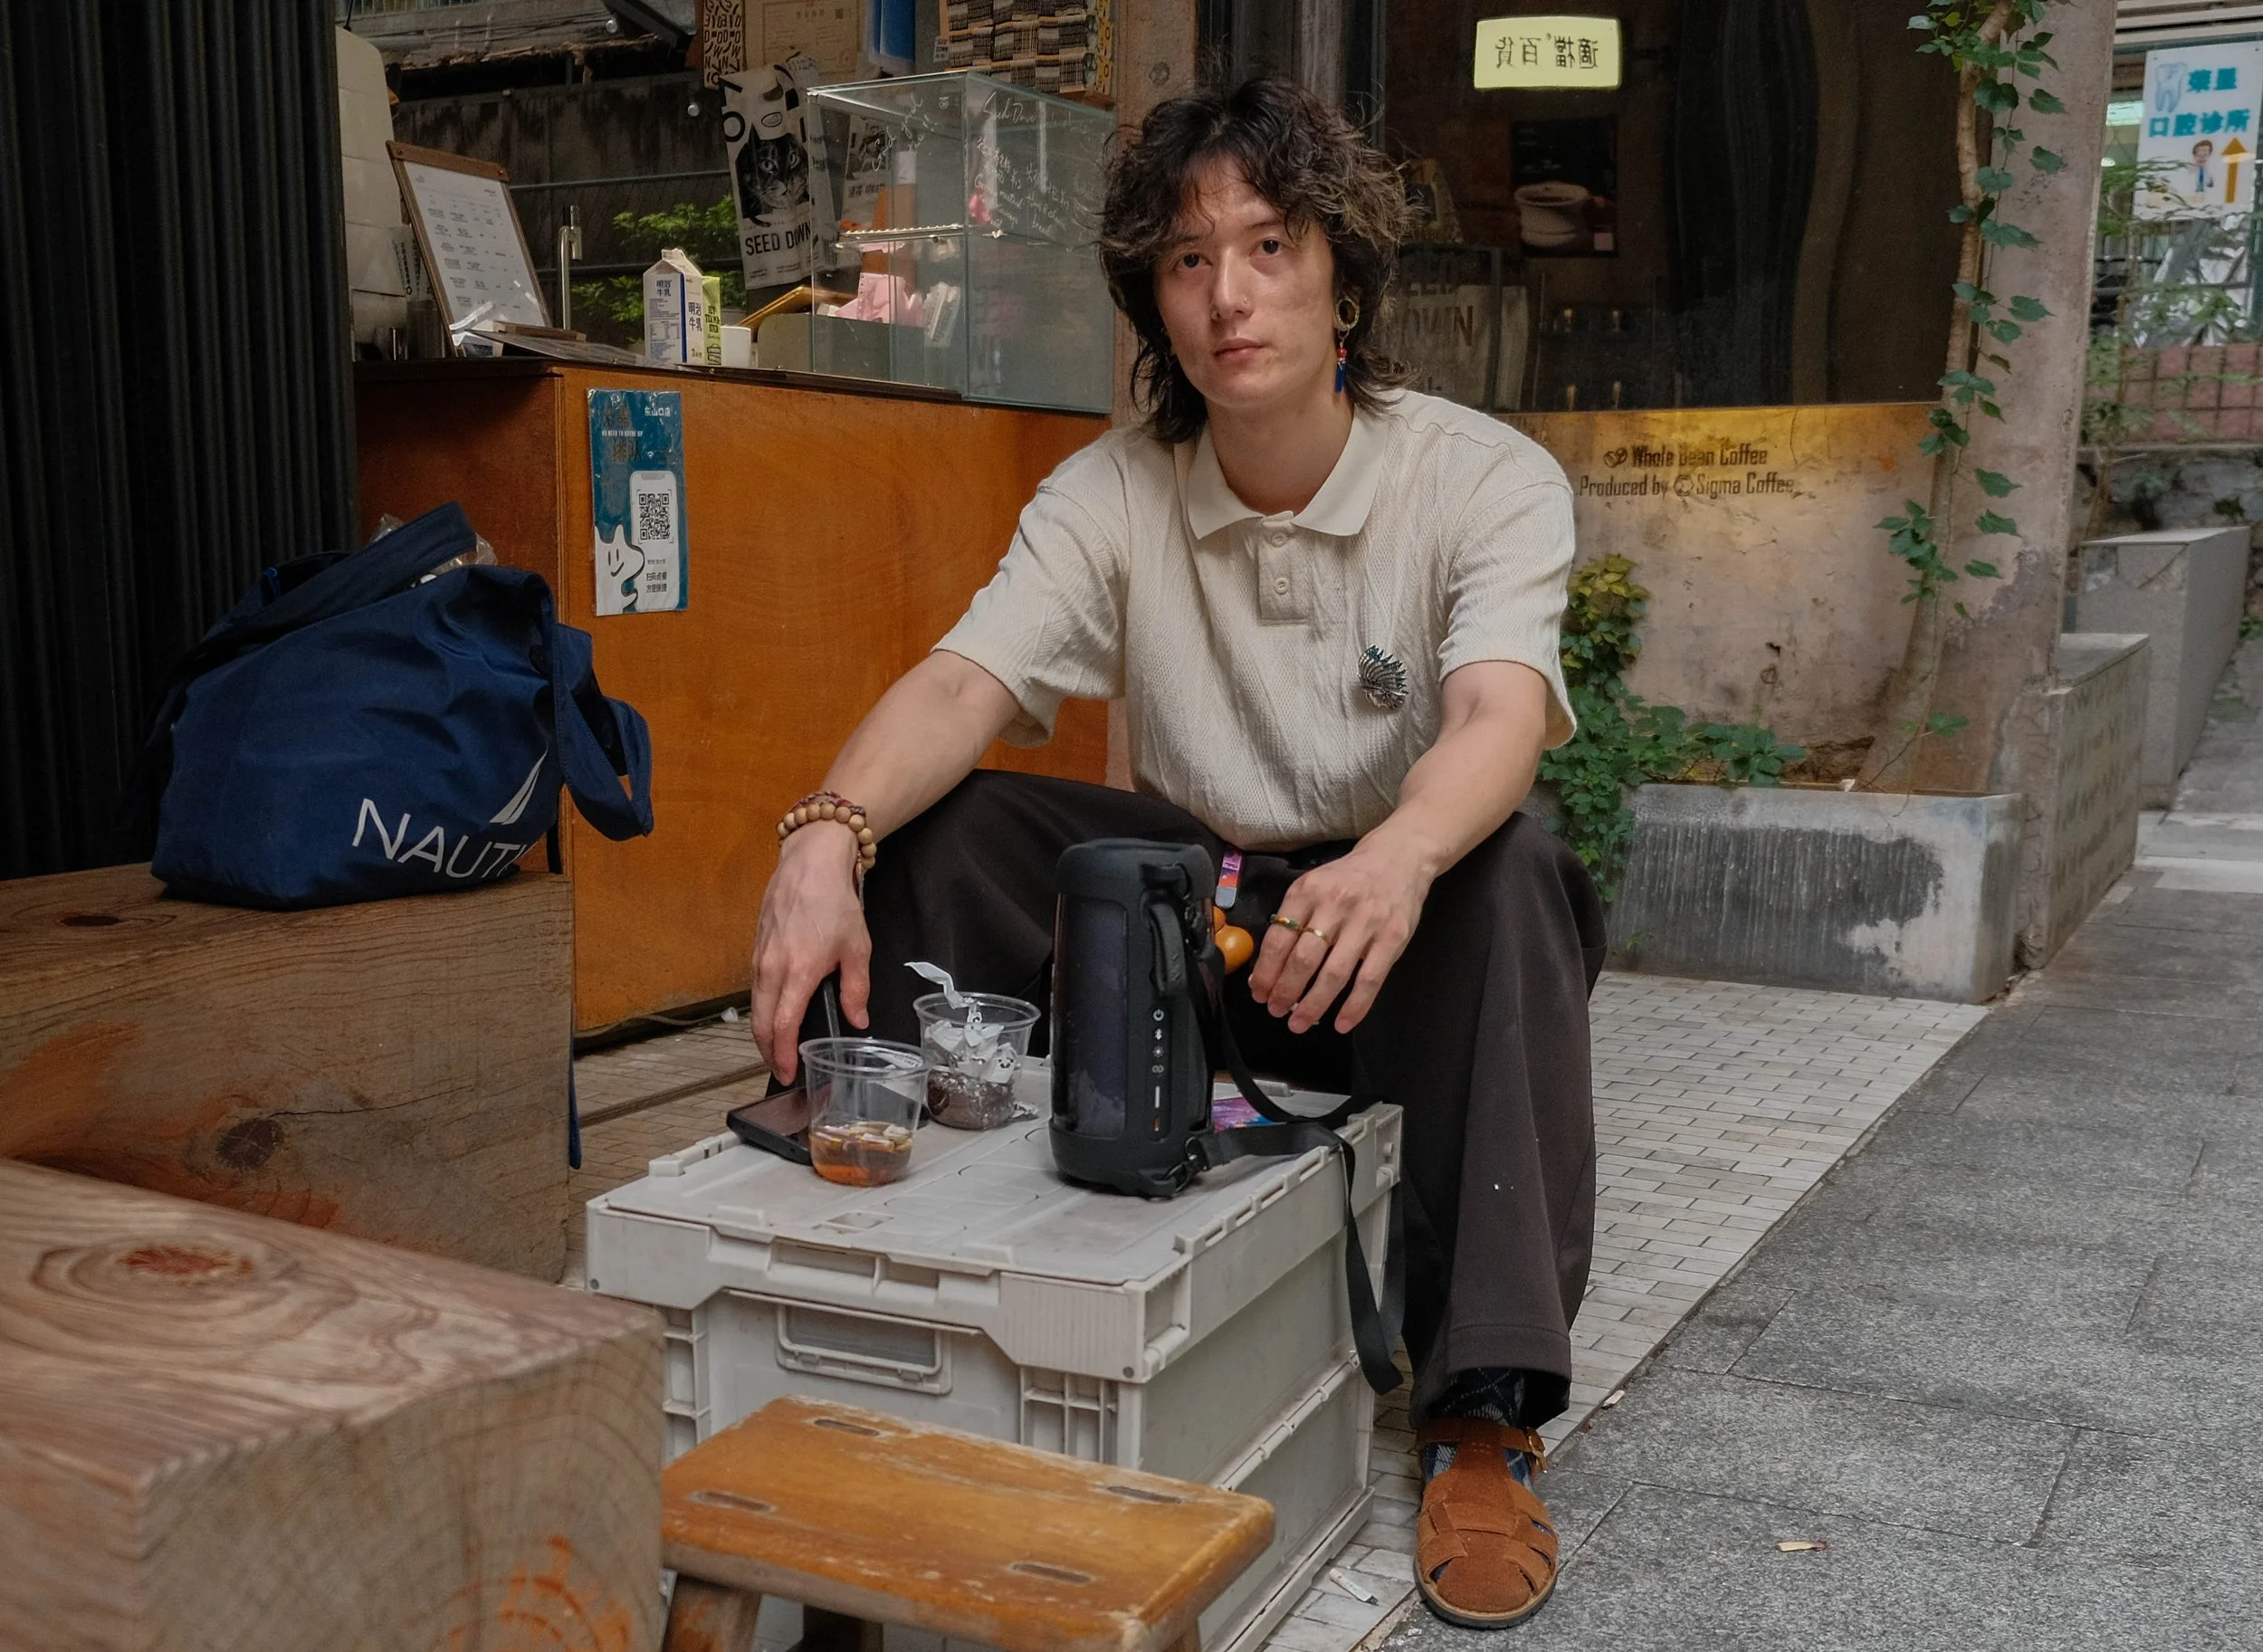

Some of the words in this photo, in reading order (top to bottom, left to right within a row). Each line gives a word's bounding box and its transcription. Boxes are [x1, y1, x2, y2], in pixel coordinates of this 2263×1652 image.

[744, 232, 781, 256] SEED
[688, 301, 702, 317] 明治
[688, 317, 702, 332] 牛乳
[1631, 444, 1674, 468] Whole
[1720, 442, 1769, 467] Coffee
[1580, 474, 1647, 497] Produced
[1652, 474, 1668, 499] by
[1696, 473, 1741, 500] Sigma
[1746, 471, 1795, 495] Coffee
